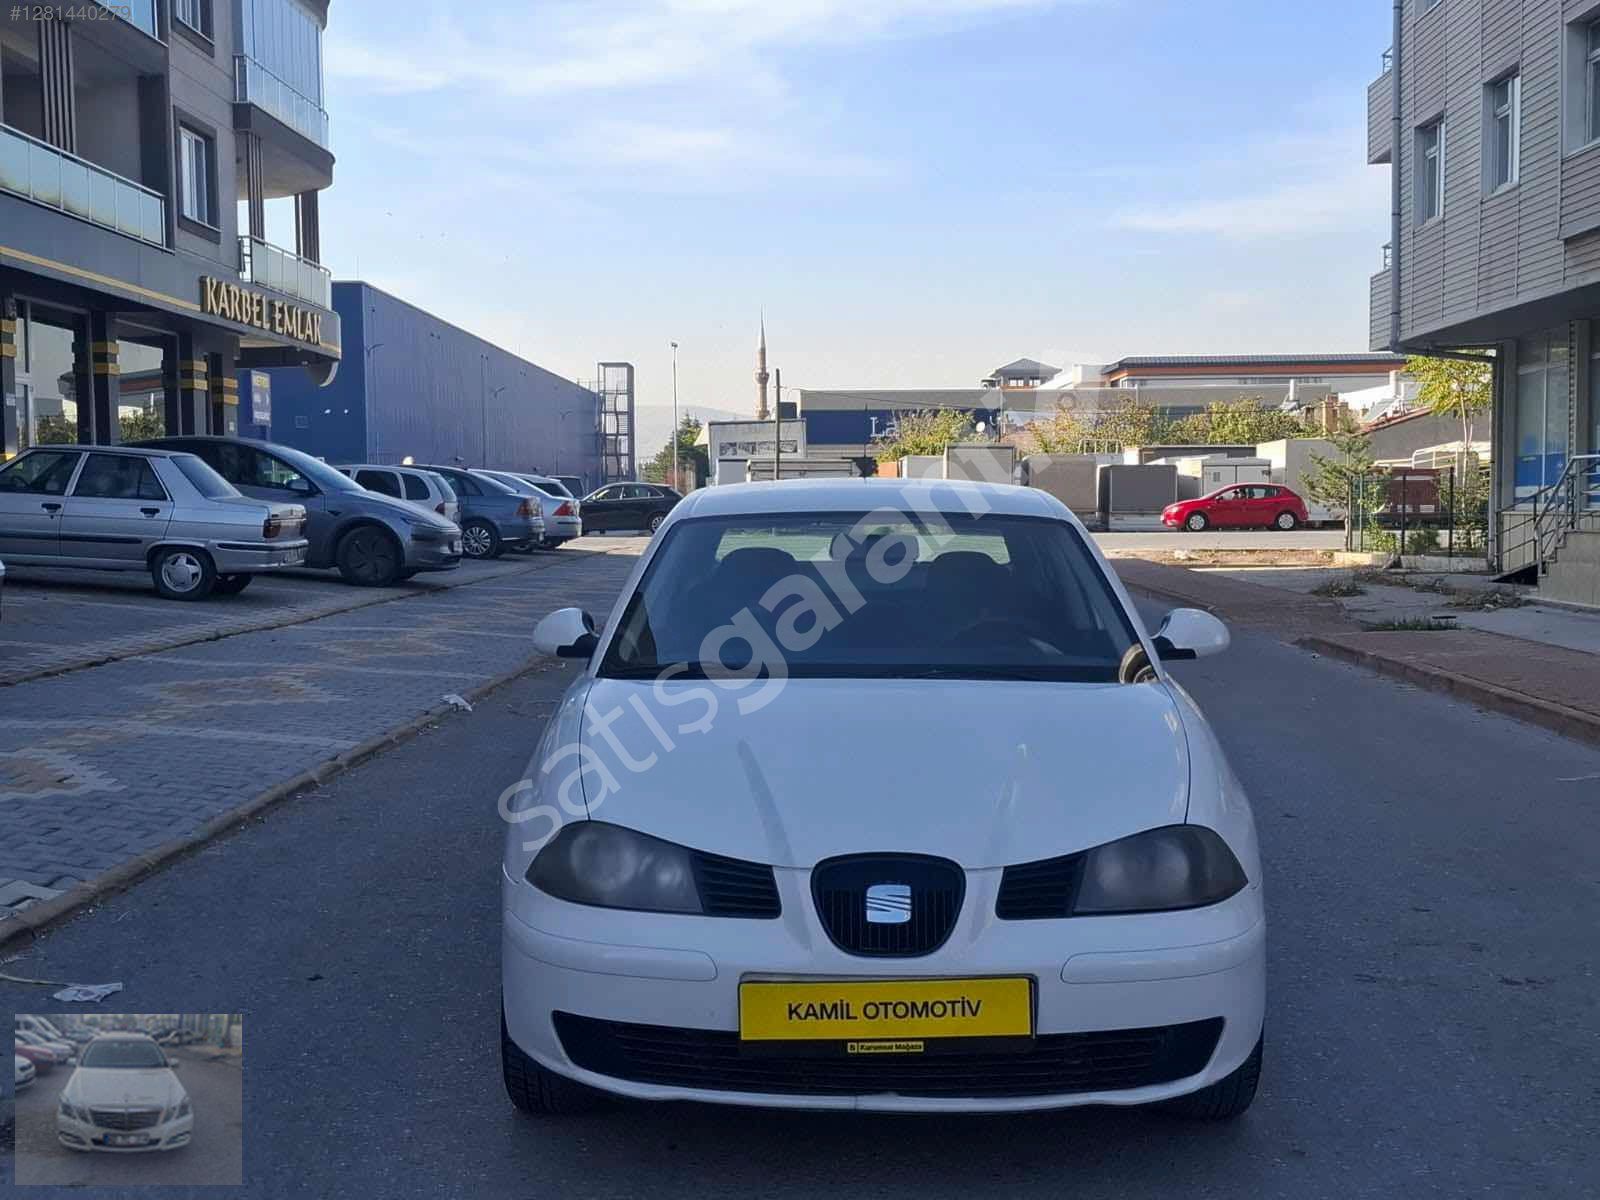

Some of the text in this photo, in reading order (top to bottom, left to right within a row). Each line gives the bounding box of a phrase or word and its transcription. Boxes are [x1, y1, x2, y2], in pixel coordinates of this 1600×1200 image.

[206, 275, 321, 345] KARBEL EMLAK
[788, 996, 982, 1021] KAMİL OTOMOTİV
